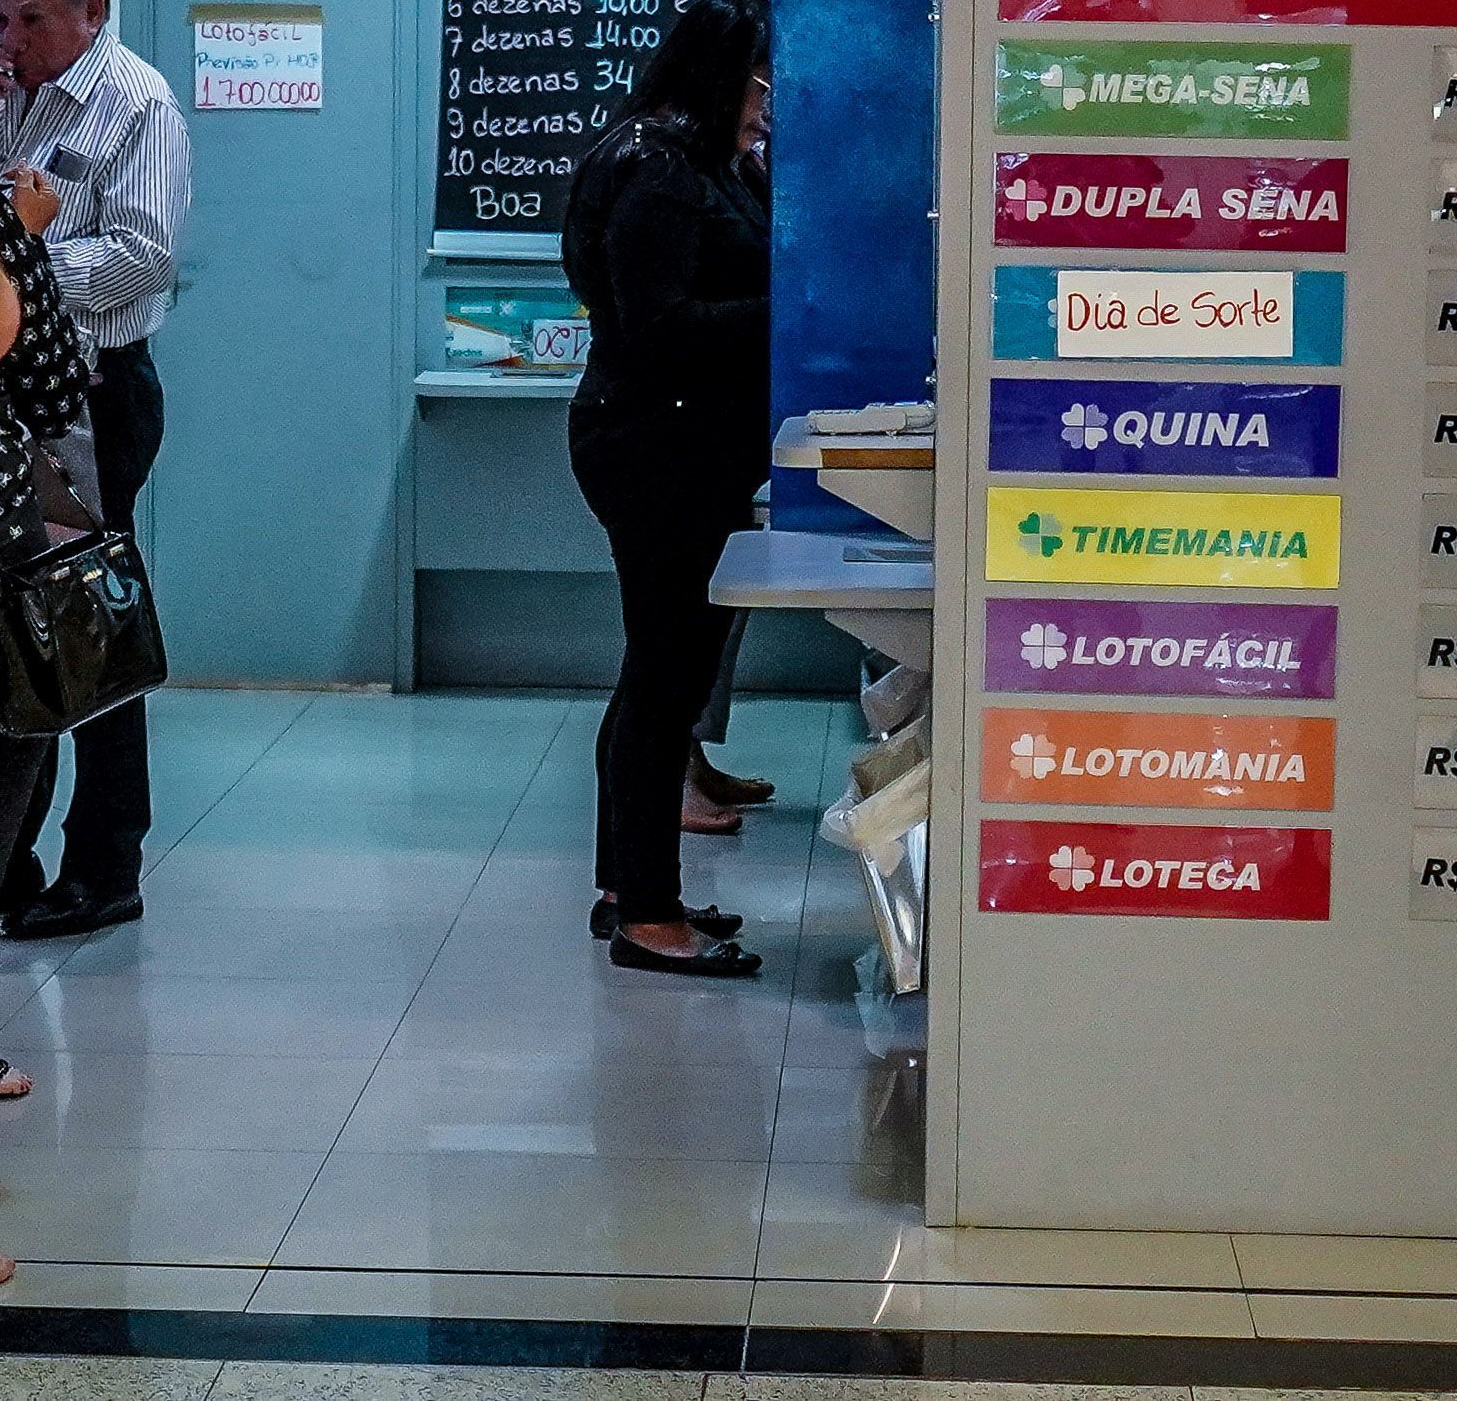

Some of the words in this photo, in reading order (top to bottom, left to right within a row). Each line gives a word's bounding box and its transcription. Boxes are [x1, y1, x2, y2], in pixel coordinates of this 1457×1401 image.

[444, 26, 464, 58] 7
[471, 24, 574, 53] dezenas
[447, 65, 462, 99] 8
[468, 64, 580, 95] dezenas
[593, 59, 634, 95] 34
[1088, 73, 1311, 106] MEGA-SENA
[446, 106, 465, 140] 9
[472, 104, 584, 137] dezenas
[443, 145, 475, 177] 10
[480, 147, 578, 177] dezena
[469, 185, 542, 220] Boa
[1050, 185, 1203, 219] DUPLA
[1218, 187, 1340, 222] SENA
[1065, 291, 1128, 332] Dia
[1136, 289, 1182, 327] de
[1192, 291, 1281, 330] Sorte
[1112, 411, 1271, 450] QUINA
[1072, 526, 1309, 559] TIMEMANIA
[1070, 631, 1301, 671] LOTOFÁCIL
[1060, 746, 1306, 783] LOTOMANIA
[1098, 858, 1262, 892] LOTECA
